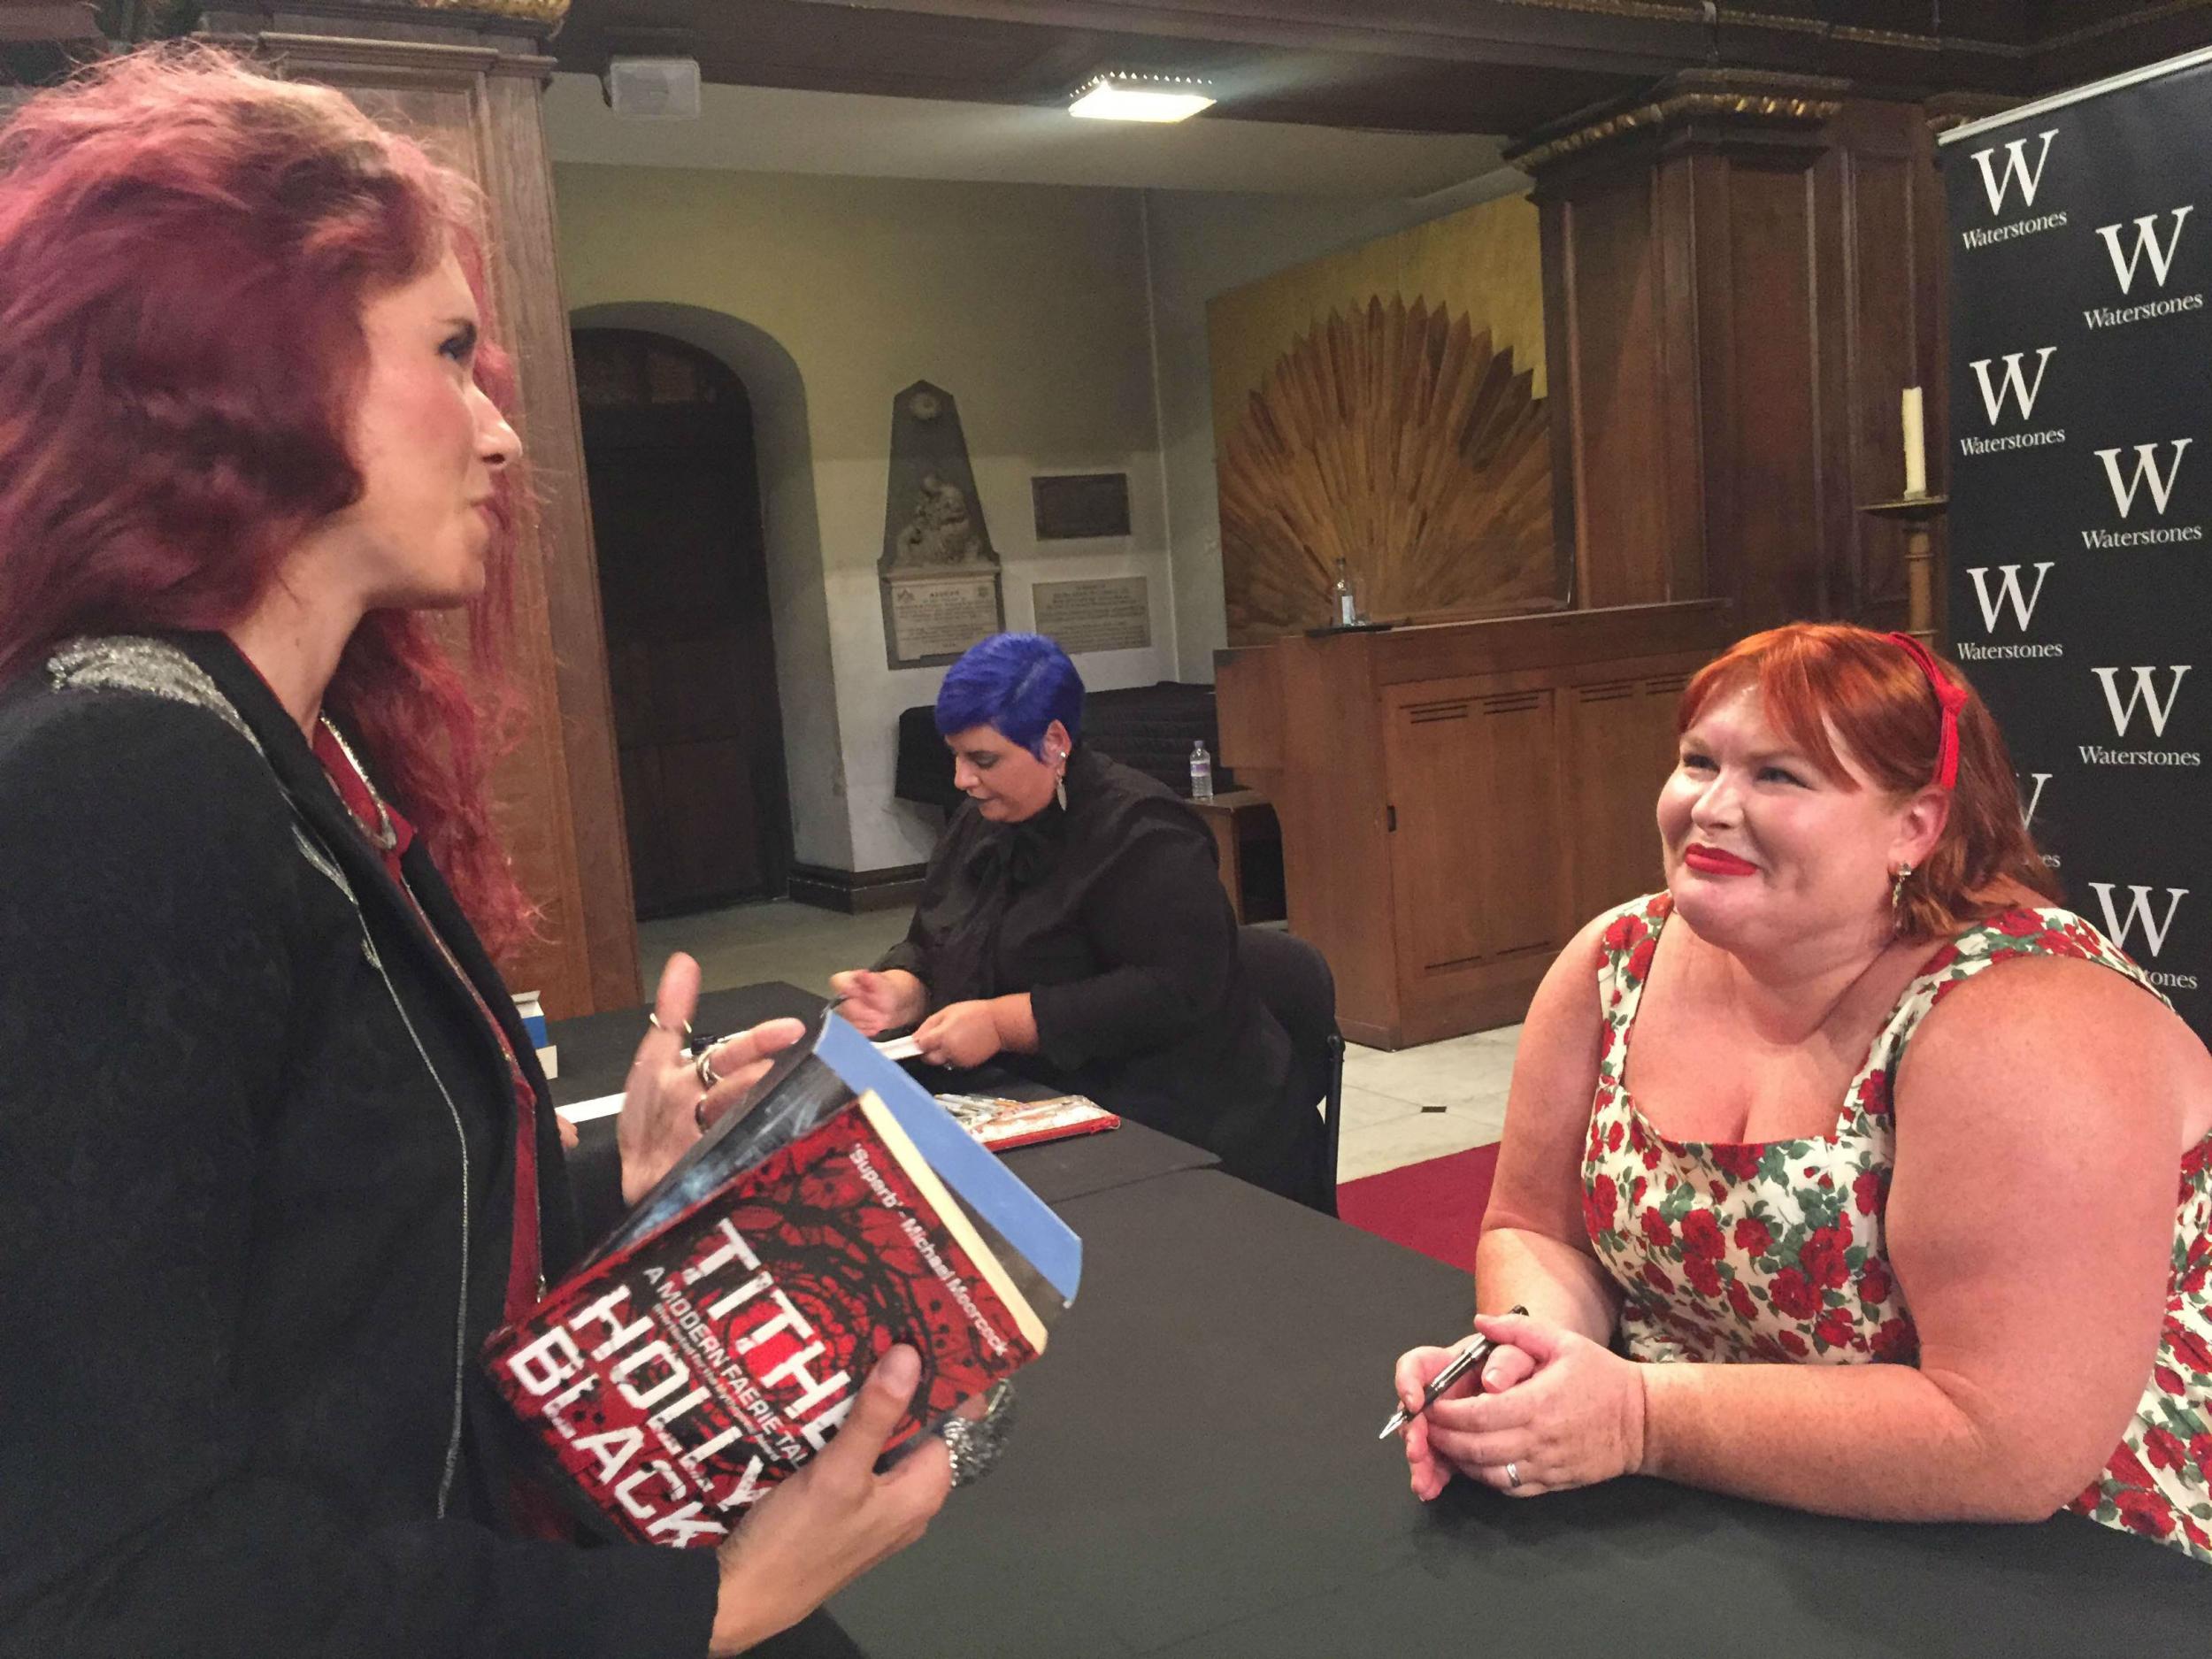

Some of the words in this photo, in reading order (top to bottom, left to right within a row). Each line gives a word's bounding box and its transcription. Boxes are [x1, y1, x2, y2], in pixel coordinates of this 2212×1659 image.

[1970, 128, 2059, 216] W
[1962, 211, 2068, 250] Waterstones
[2095, 205, 2194, 295] W
[2083, 293, 2204, 330] Waterstones
[1969, 346, 2057, 426] W
[1960, 428, 2066, 457] Waterstones
[2093, 437, 2193, 518] W
[2081, 525, 2203, 549] Waterstones
[1966, 561, 2055, 634] W
[1956, 641, 2063, 661] Waterstones
[2091, 665, 2192, 738] W
[2078, 745, 2200, 765] Waterstones
[2088, 882, 2190, 957] W
[901, 1217, 956, 1281] Michael
[568, 1285, 772, 1512] HOLLY
[643, 1266, 664, 1285] A
[656, 1280, 730, 1369] MODERN
[721, 1363, 785, 1435] FAERIE
[776, 1432, 811, 1469] TAL
[506, 1325, 729, 1548] BLACK
